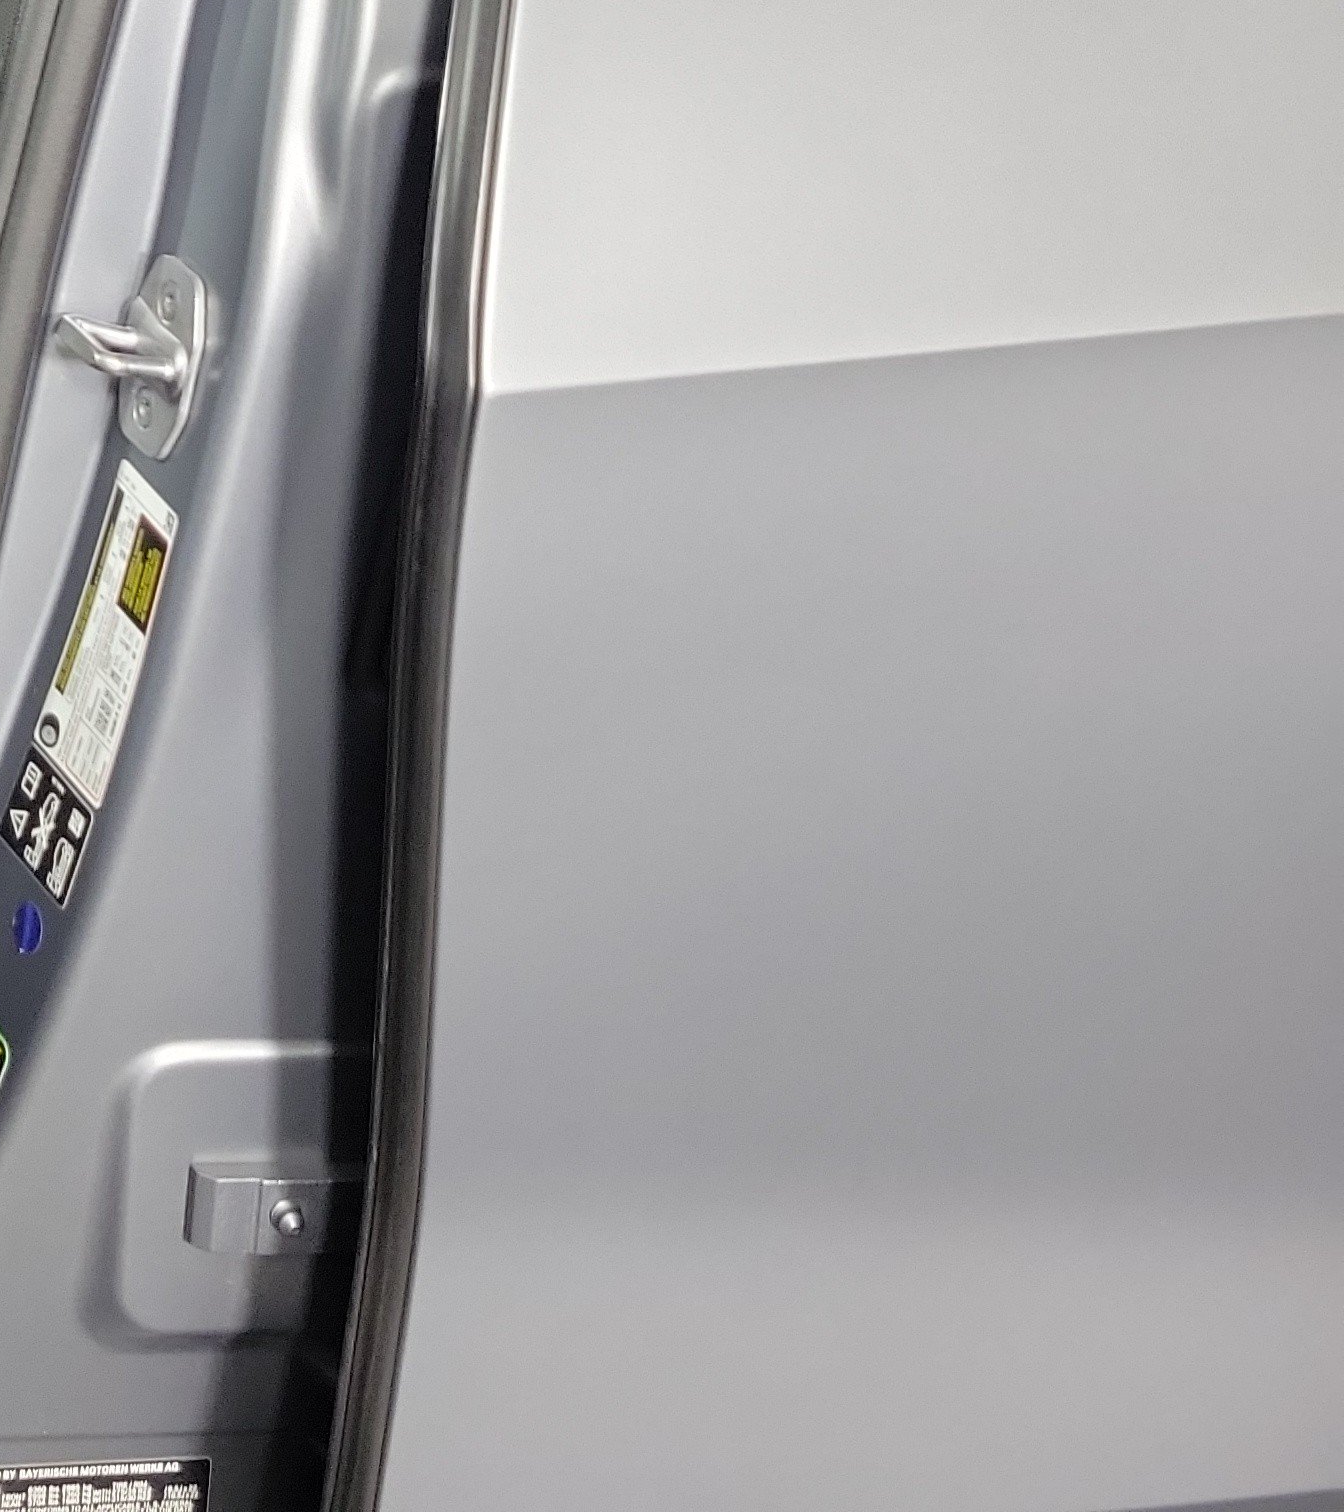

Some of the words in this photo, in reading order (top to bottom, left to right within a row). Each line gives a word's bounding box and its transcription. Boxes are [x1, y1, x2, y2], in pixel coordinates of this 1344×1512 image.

[79, 1463, 129, 1477] MOTOREN
[129, 1462, 164, 1475] WERKE
[164, 1461, 181, 1473] AG
